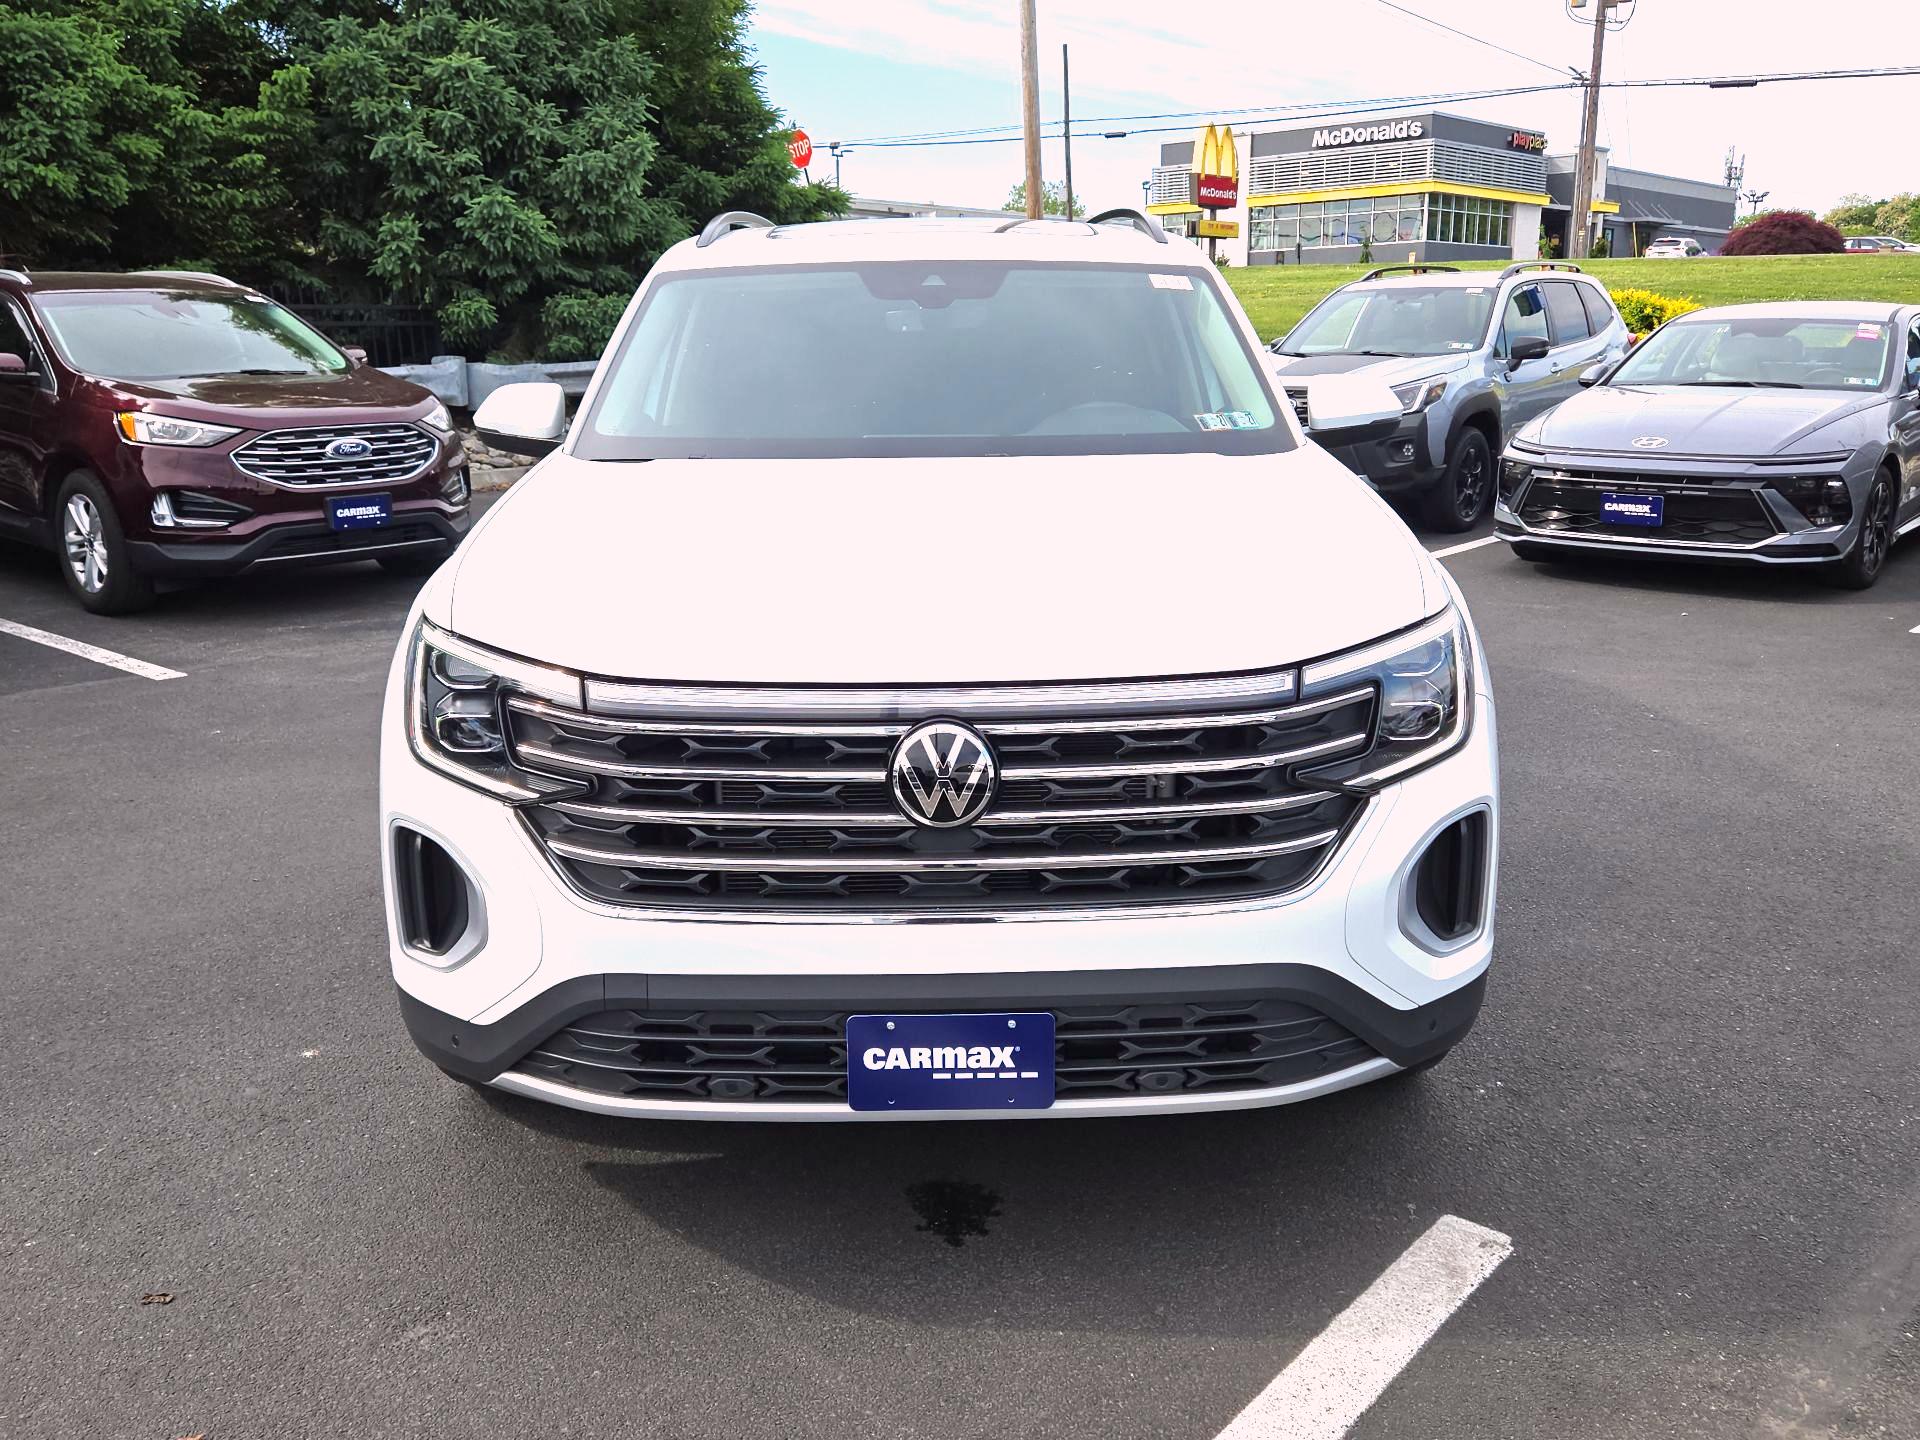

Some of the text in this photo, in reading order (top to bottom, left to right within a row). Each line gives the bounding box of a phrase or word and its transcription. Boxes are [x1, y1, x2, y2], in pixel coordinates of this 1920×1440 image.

[1311, 119, 1423, 148] McDonald's
[788, 138, 810, 159] STOP
[1200, 186, 1238, 200] McDonald's
[339, 443, 363, 455] Ford
